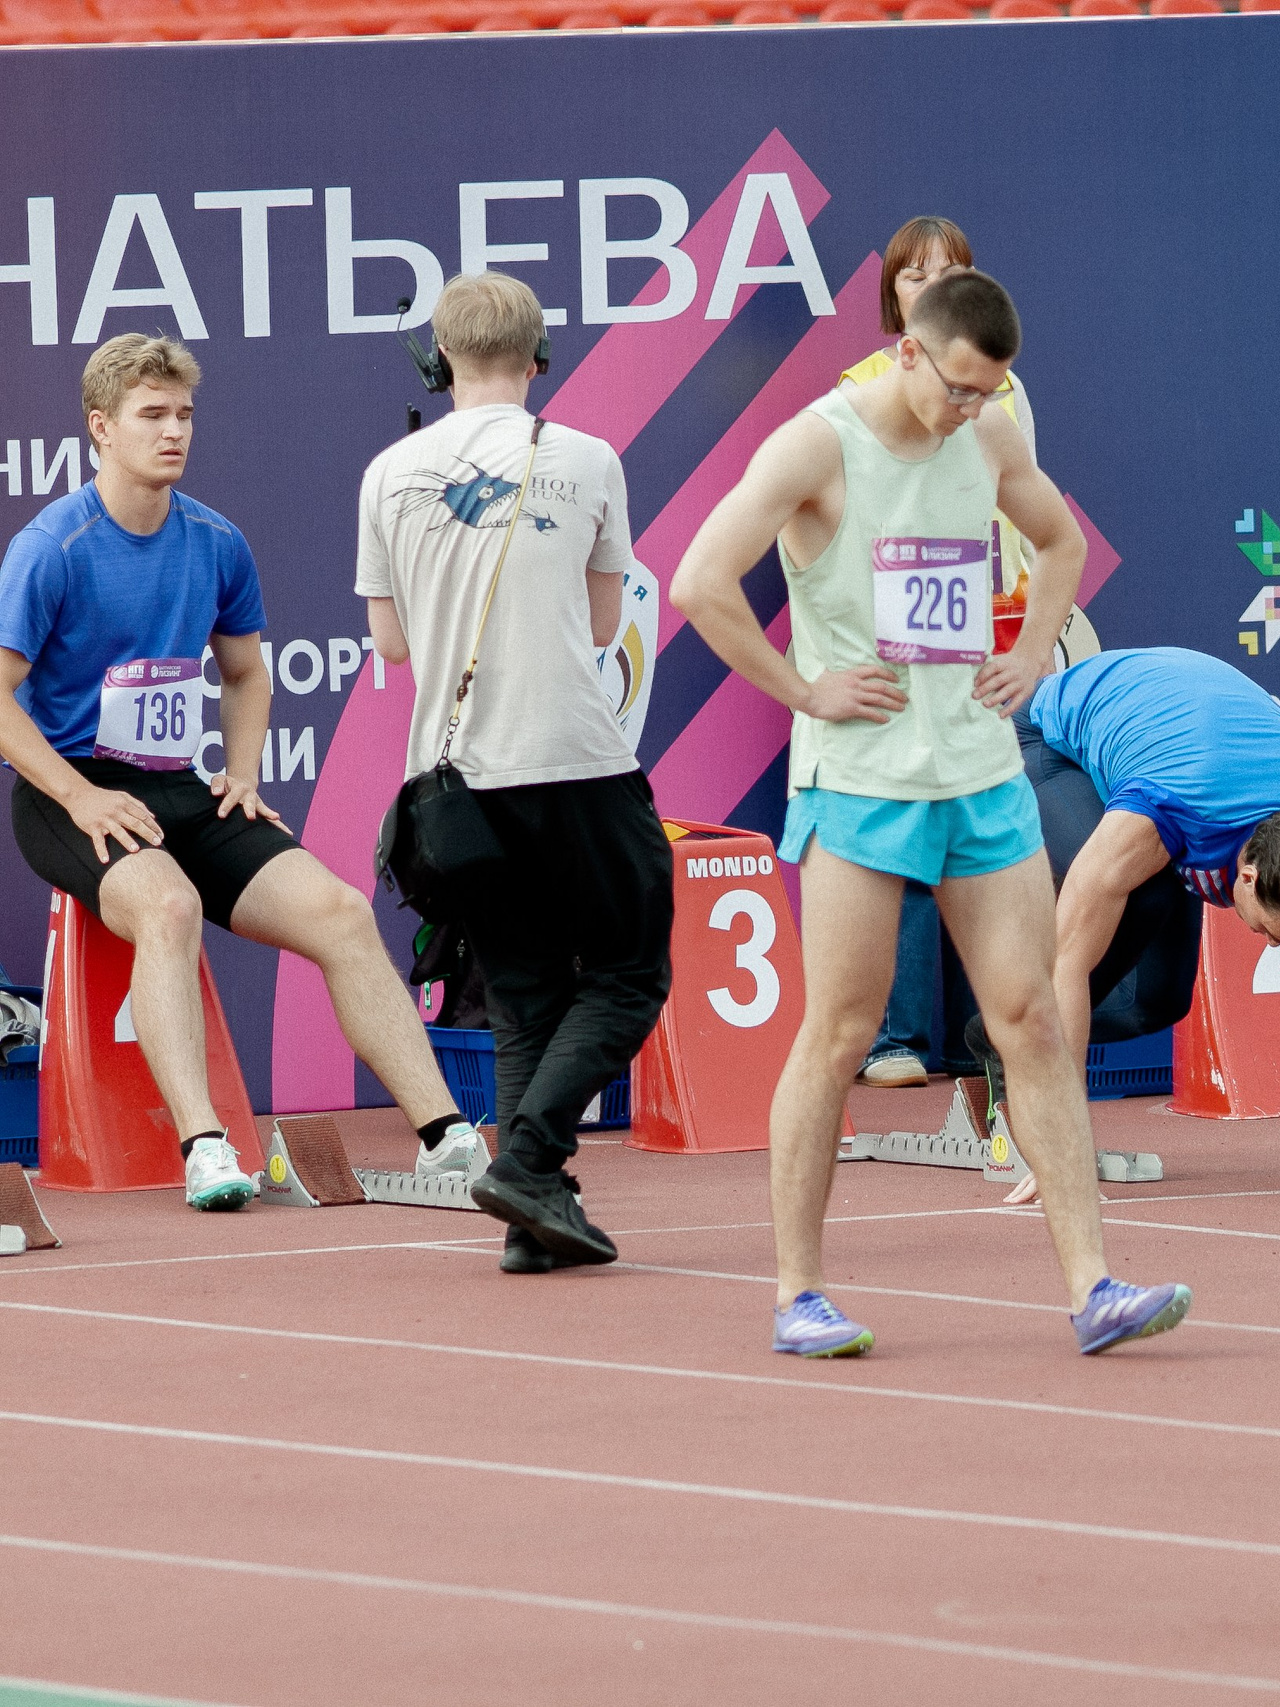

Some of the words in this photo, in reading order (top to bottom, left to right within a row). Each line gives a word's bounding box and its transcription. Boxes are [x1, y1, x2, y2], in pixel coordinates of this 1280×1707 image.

[529, 489, 578, 506] TUNA
[531, 477, 581, 495] HOT
[905, 576, 967, 631] 226
[134, 692, 186, 741] 136
[686, 855, 774, 878] MONDO
[706, 889, 781, 1028] 3
